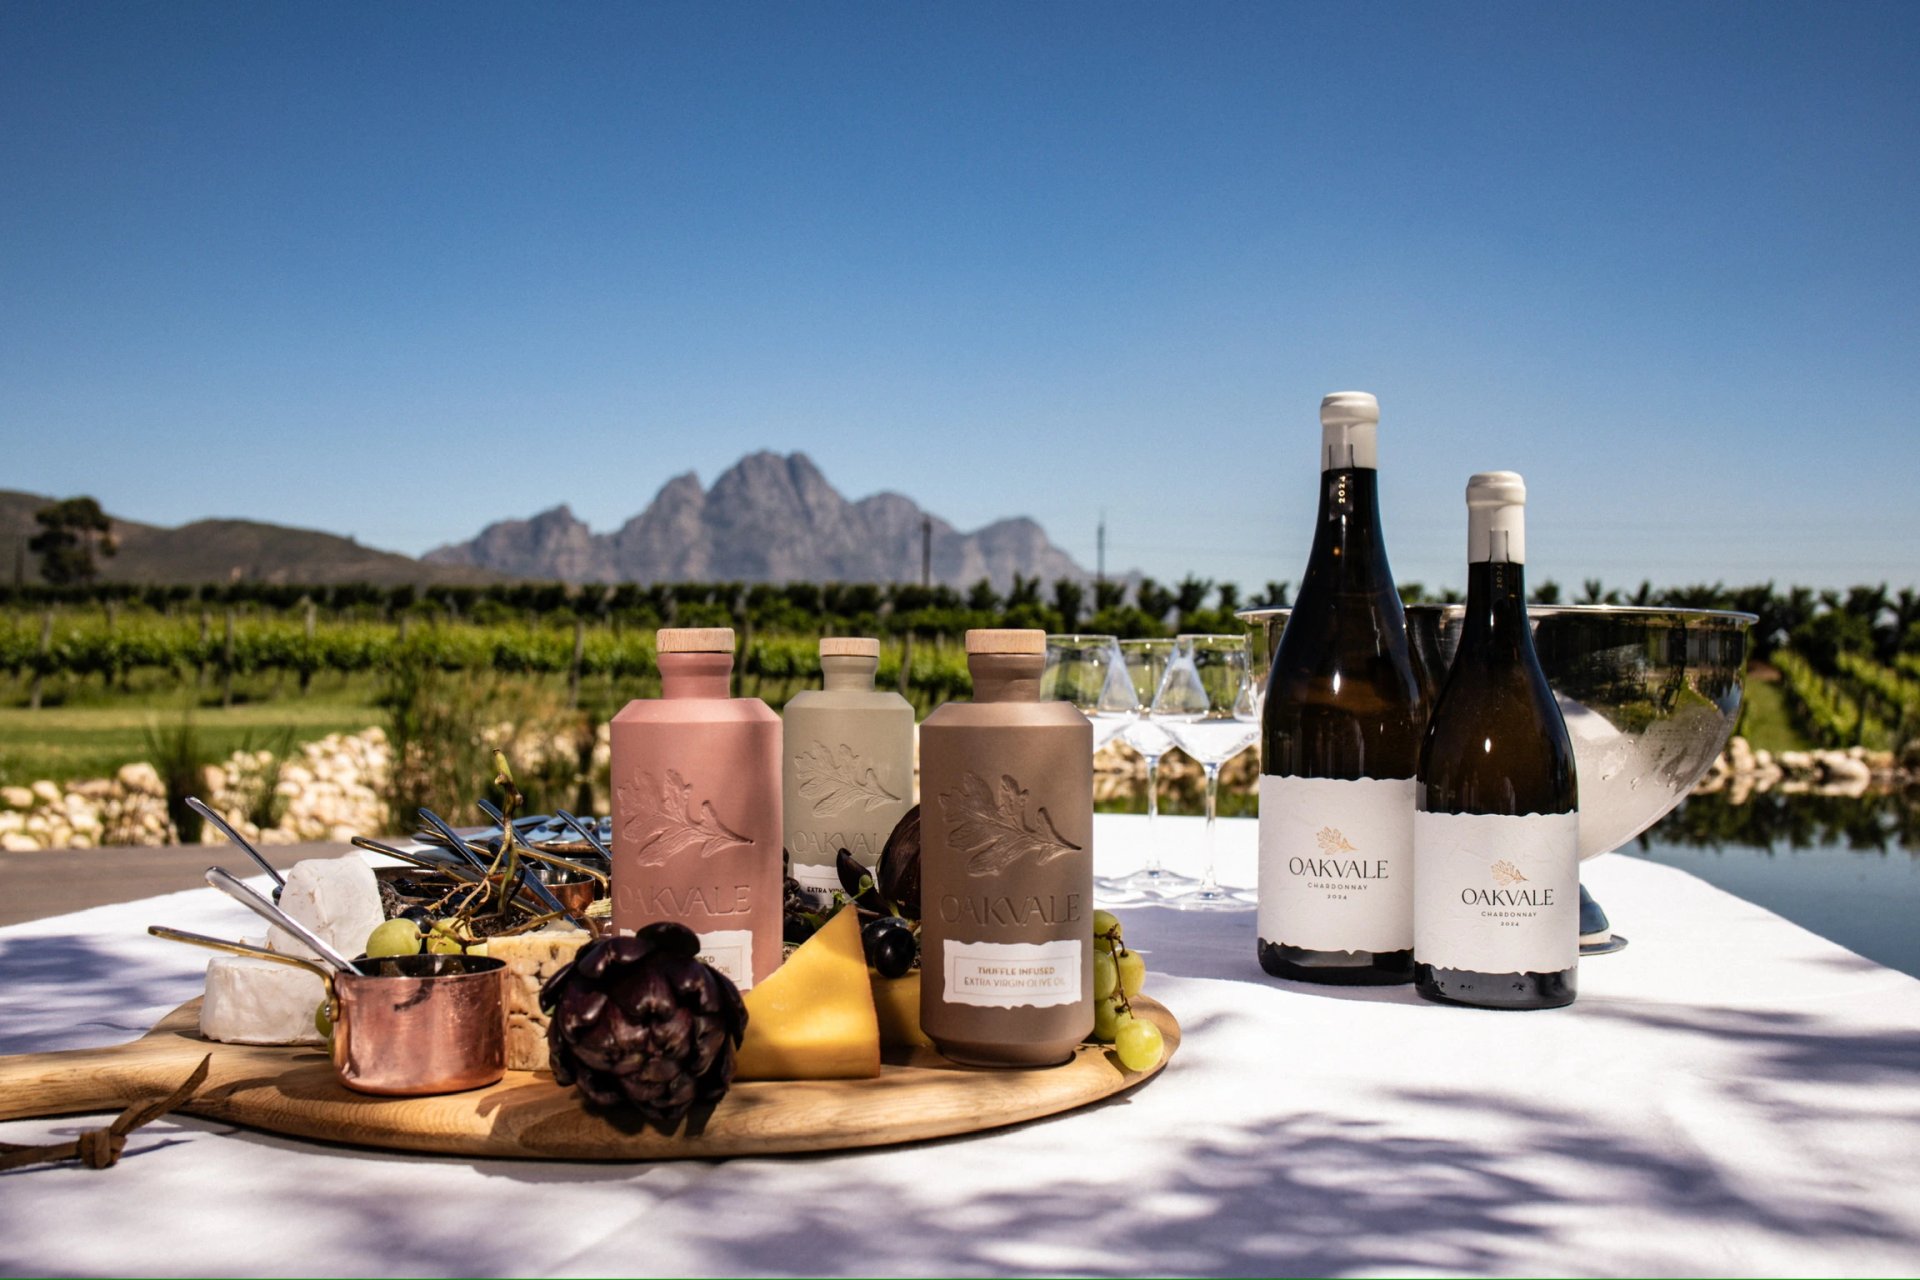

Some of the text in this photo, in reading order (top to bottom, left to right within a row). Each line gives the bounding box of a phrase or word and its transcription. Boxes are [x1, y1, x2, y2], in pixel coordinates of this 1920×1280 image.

[1338, 475, 1346, 504] 2024
[791, 830, 888, 855] OAKVAL
[1289, 857, 1389, 879] OAKVALE
[1307, 882, 1368, 890] CHARDONNAY
[1462, 888, 1554, 906] OAKVALE
[618, 886, 752, 917] OAKVALE
[940, 895, 1080, 926] OAKVALE
[1019, 966, 1055, 975] INFUSED
[964, 976, 991, 986] EXTRA
[994, 978, 1025, 988] VIRGIN
[1027, 978, 1052, 987] OLIVE
